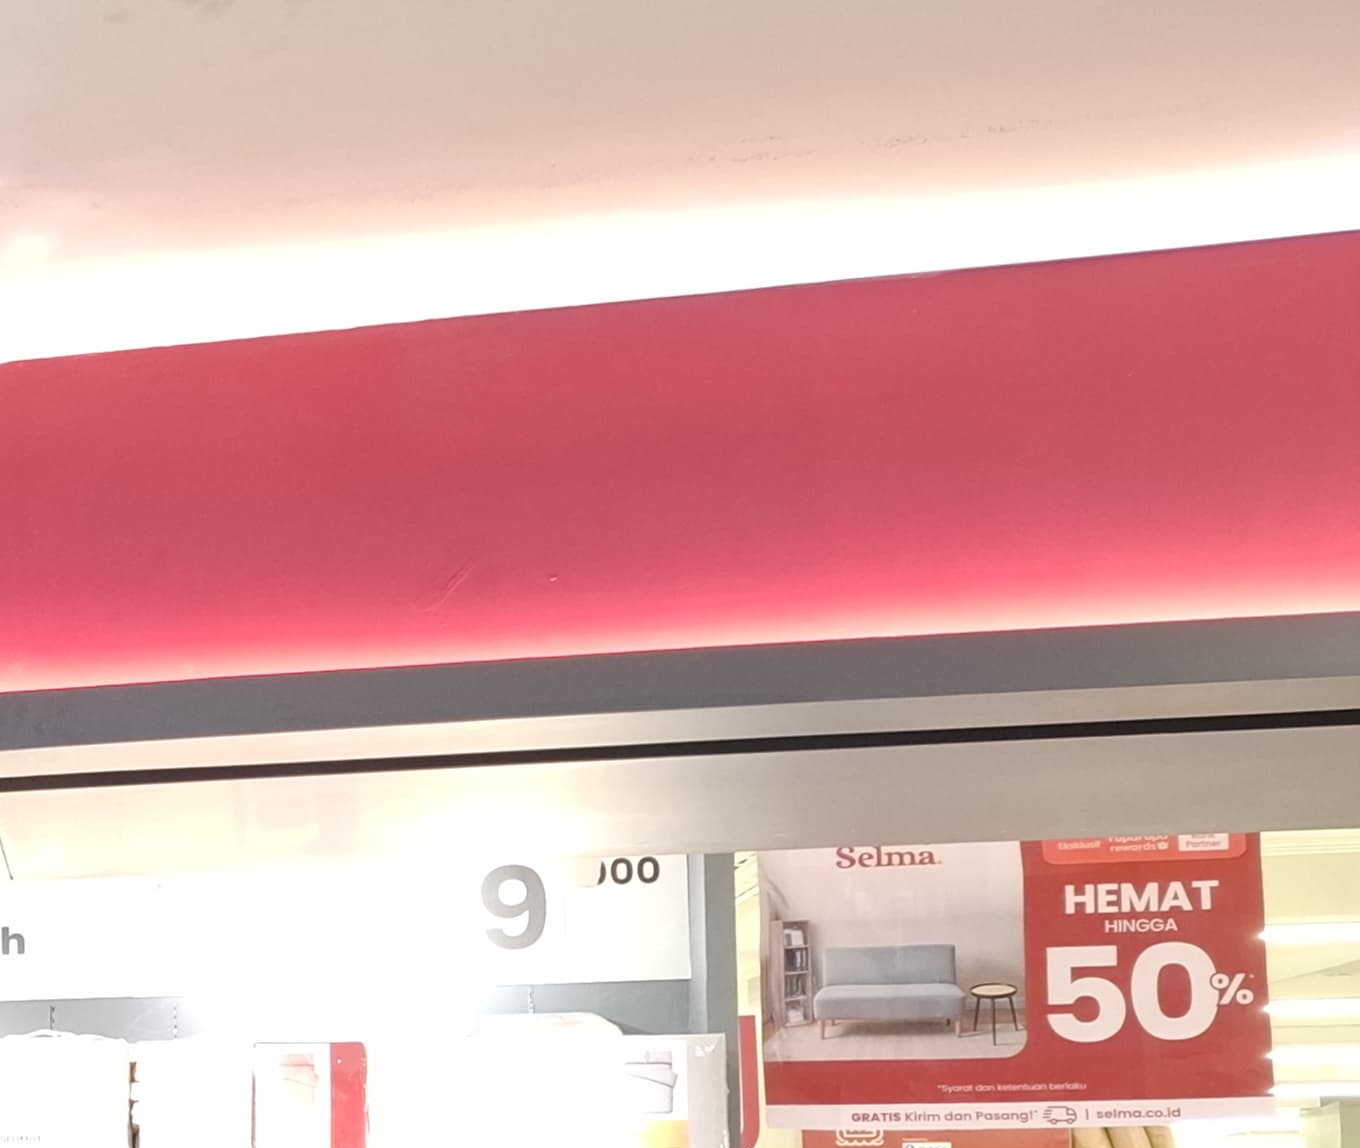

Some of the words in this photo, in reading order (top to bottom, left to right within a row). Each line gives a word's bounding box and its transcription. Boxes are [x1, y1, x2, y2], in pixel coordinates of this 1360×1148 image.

[1065, 880, 1220, 915] HEMAT
[1105, 918, 1178, 933] HINGGA
[975, 1084, 995, 1092] dan
[997, 1083, 1048, 1092] ketentuan
[1049, 1082, 1088, 1091] berlaku
[851, 1112, 902, 1123] GRATIS
[904, 1110, 942, 1122] Kirim
[944, 1110, 972, 1121] dan
[1096, 1107, 1181, 1119] selma.co.id
